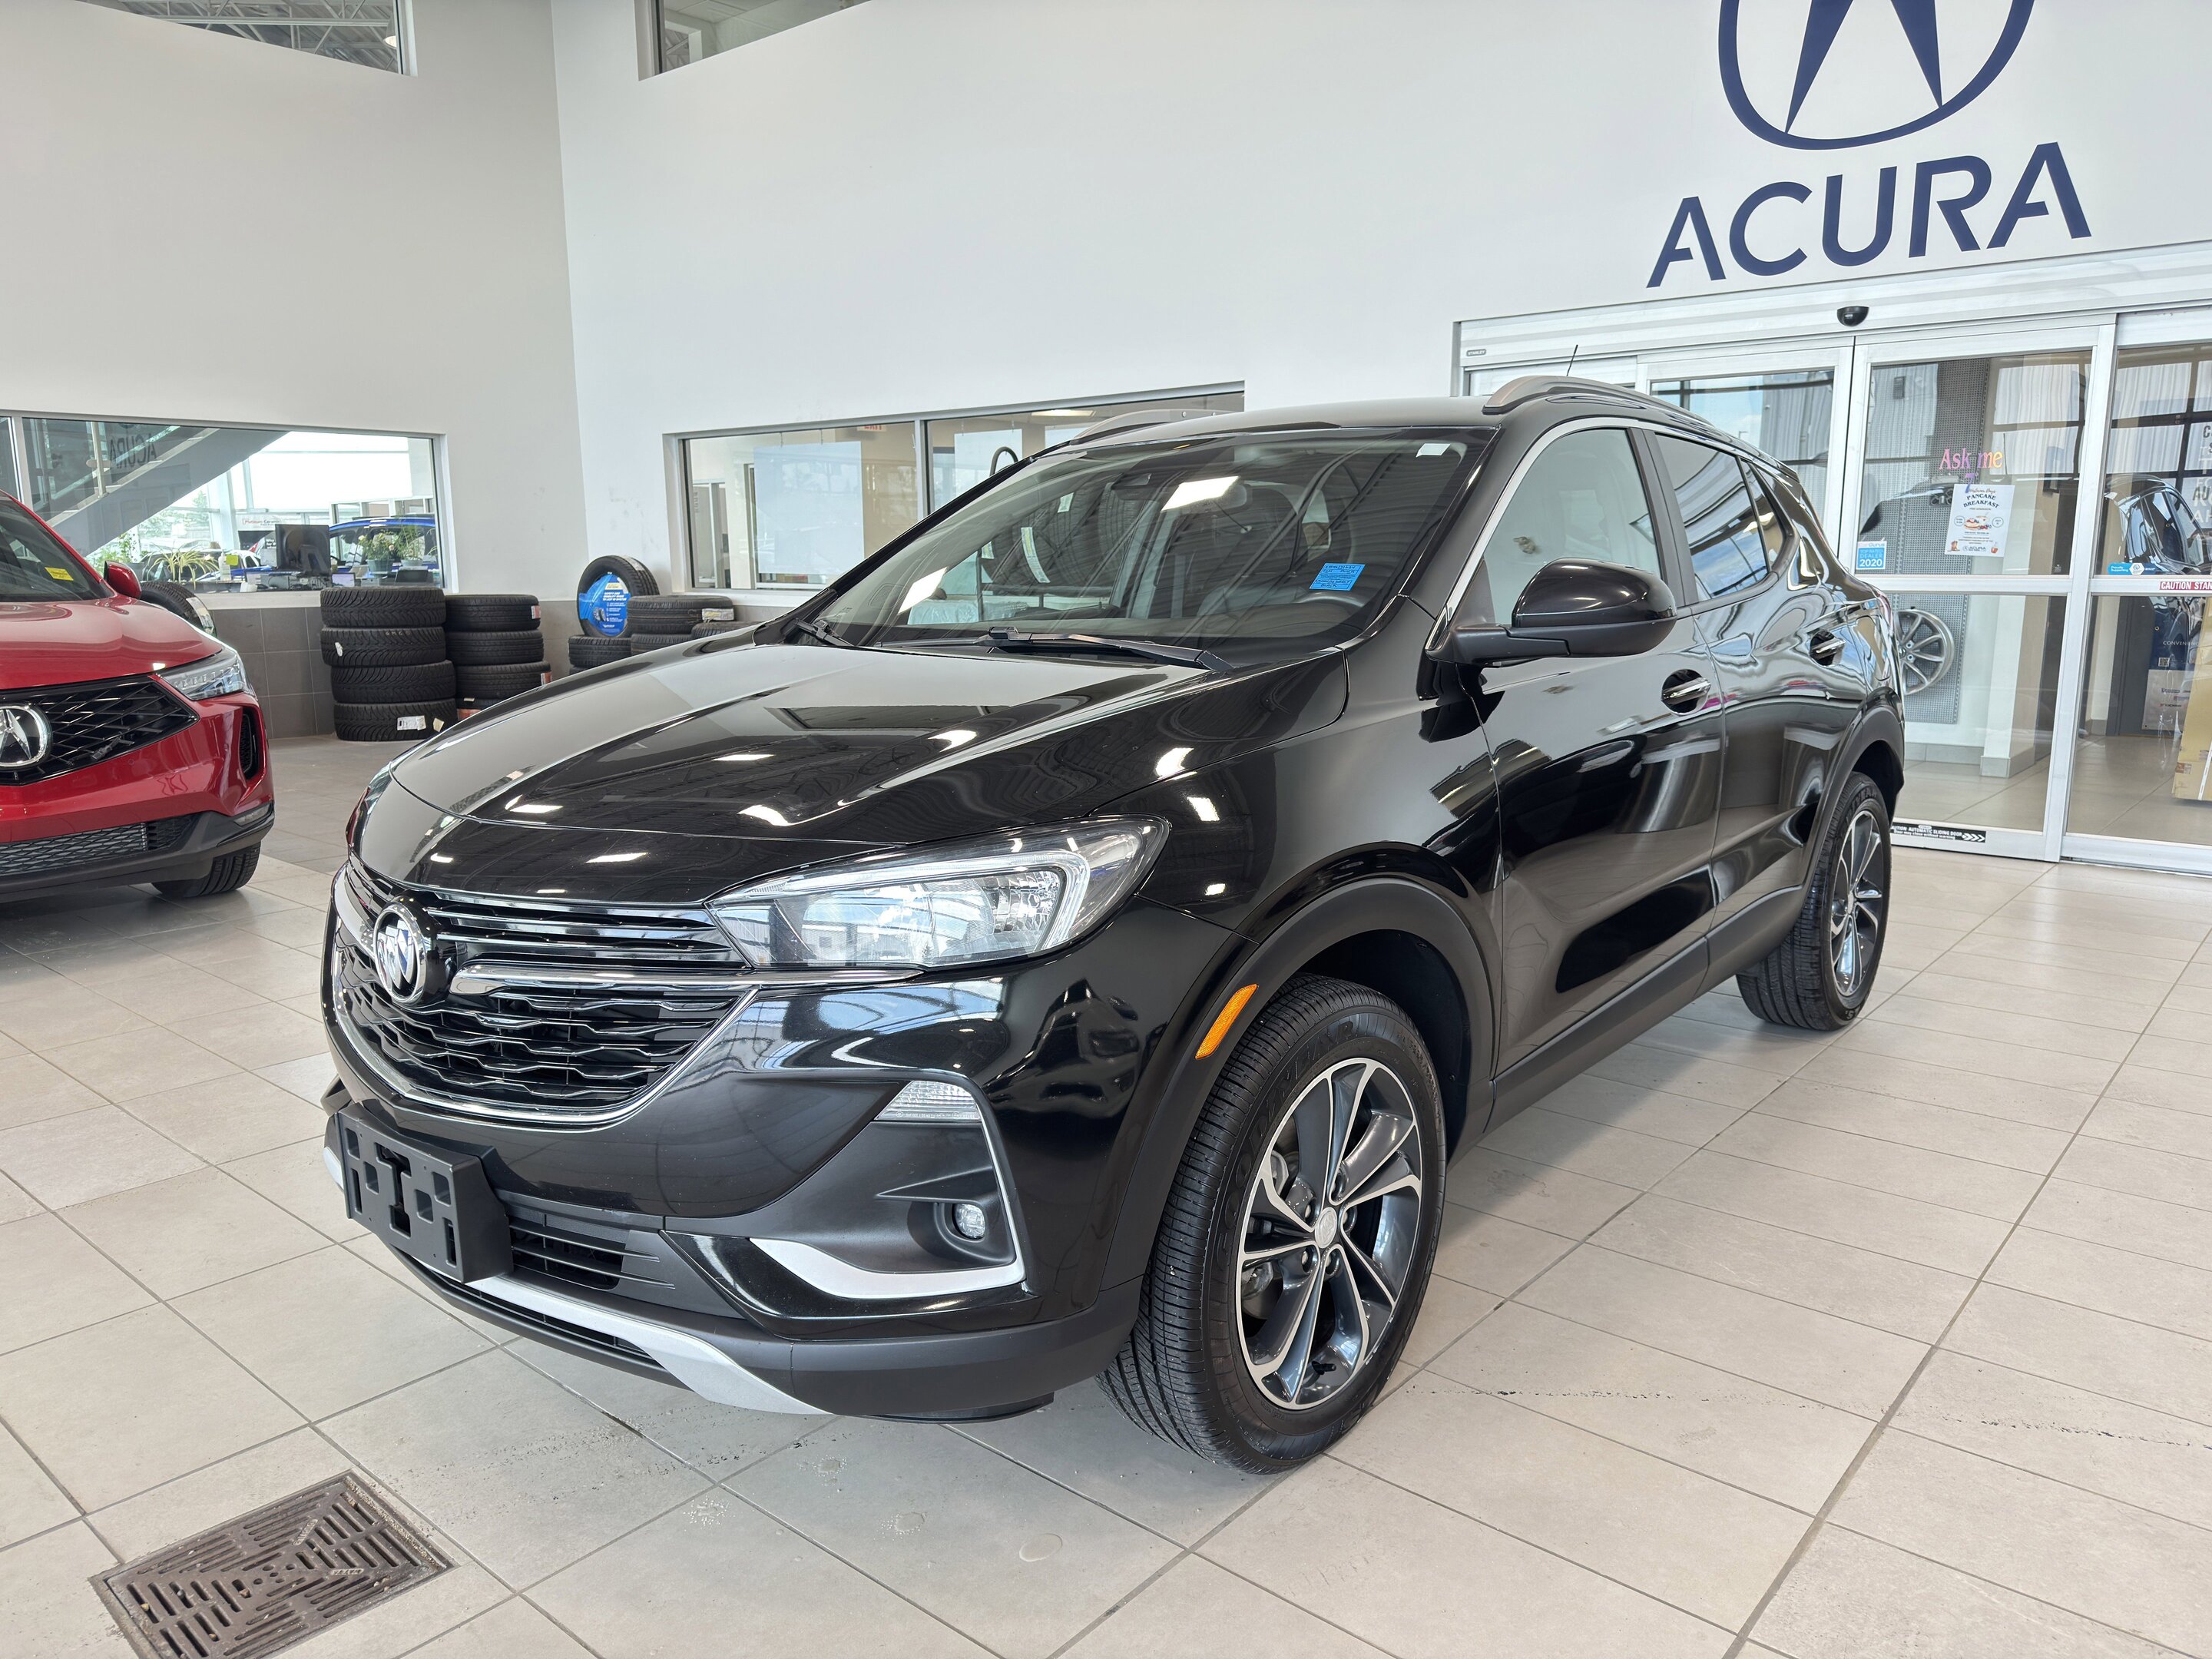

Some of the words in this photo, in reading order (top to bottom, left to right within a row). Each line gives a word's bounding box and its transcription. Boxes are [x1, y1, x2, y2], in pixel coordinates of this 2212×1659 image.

[1646, 141, 2092, 288] ACURA
[1939, 448, 1972, 470] Ask
[1977, 450, 2004, 469] me
[1963, 500, 2000, 508] BREAKFAST
[1859, 558, 1883, 567] 2020
[2161, 581, 2192, 590] CAUTION
